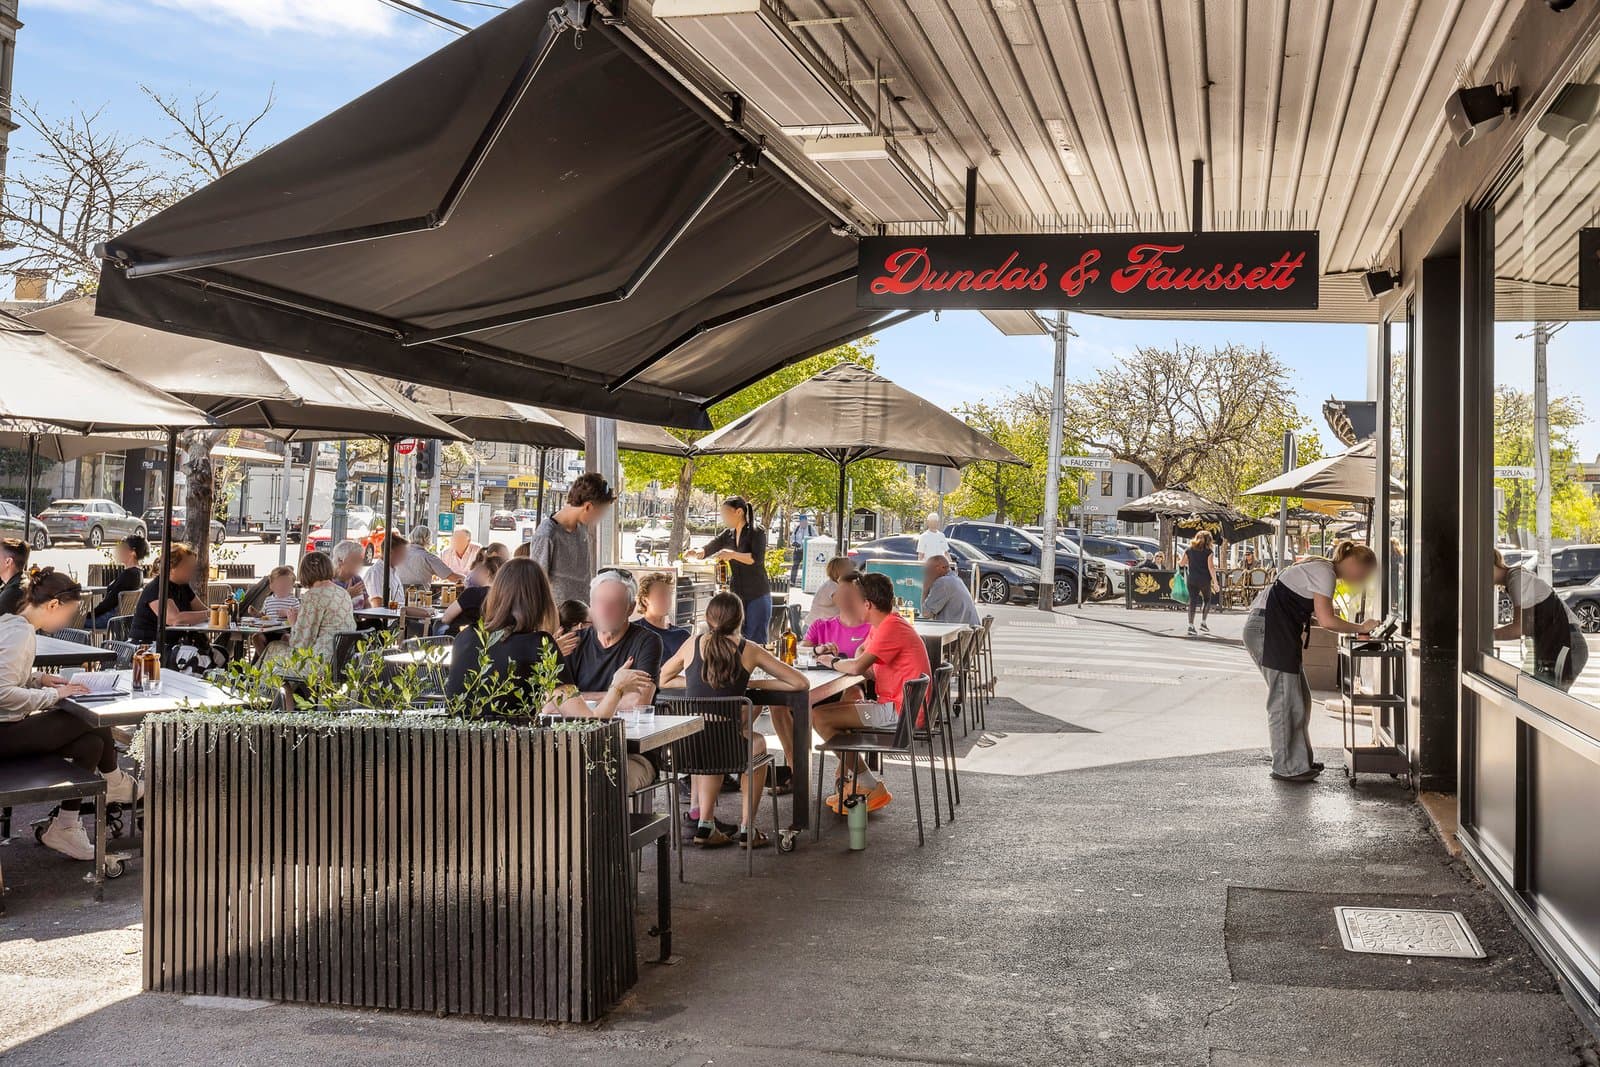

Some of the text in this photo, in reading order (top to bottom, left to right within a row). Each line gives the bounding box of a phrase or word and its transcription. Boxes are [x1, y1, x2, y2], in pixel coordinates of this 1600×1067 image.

[870, 244, 1307, 297] Dundas & Faussett
[1070, 459, 1103, 467] FAUSSETT
